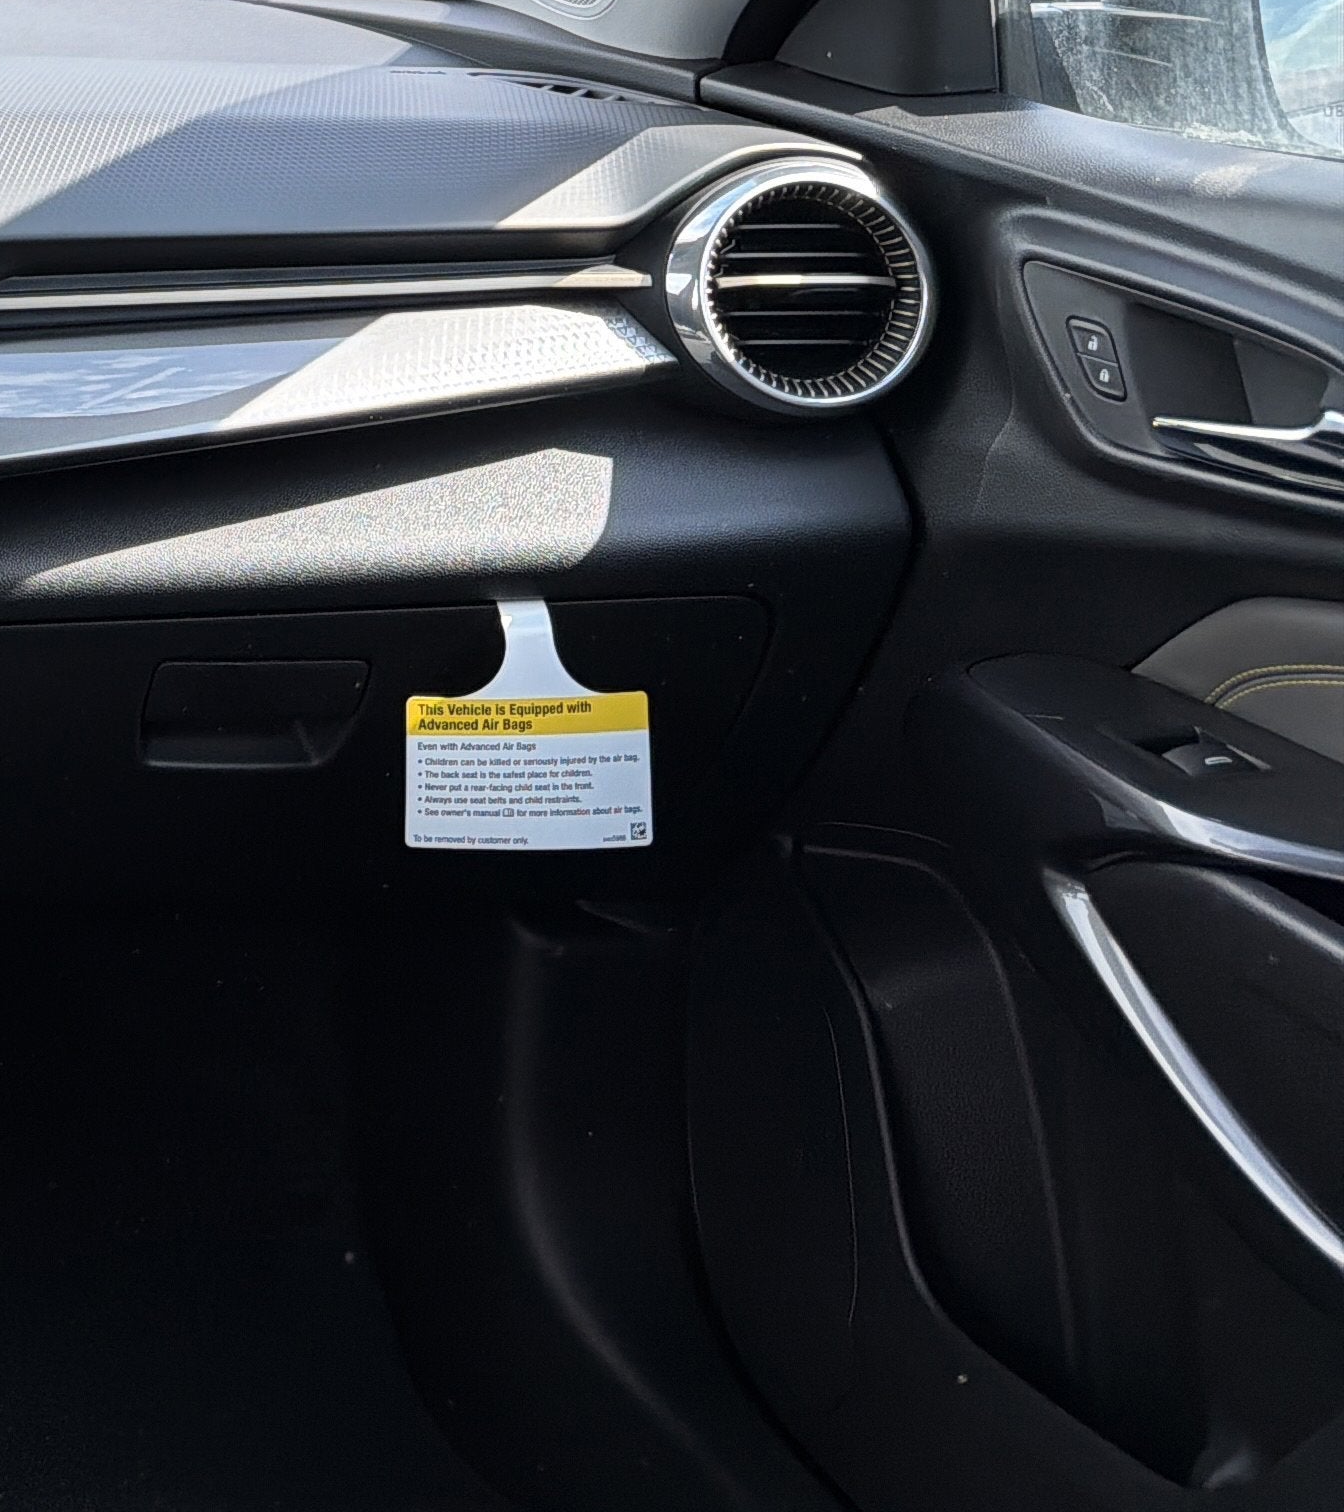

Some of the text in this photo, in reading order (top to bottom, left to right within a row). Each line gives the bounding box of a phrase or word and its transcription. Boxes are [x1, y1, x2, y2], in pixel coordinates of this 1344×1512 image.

[417, 700, 592, 718] This Vehicle is Equipped with
[417, 718, 533, 733] Advanced Air Bags
[417, 742, 537, 752] Even with Advanced Air Bags
[424, 757, 459, 766] Children
[477, 758, 488, 766] be
[489, 758, 511, 766] killed
[523, 757, 558, 766] seriously
[560, 756, 587, 766] injured
[588, 756, 597, 765] by
[599, 755, 611, 763] the
[613, 754, 622, 763] air
[624, 754, 640, 763] bag.
[424, 769, 593, 780] The back seat is the safest place for children.
[424, 808, 439, 816] See
[441, 808, 471, 817] owner's
[473, 809, 501, 817] manual
[516, 809, 527, 817] for
[549, 808, 591, 817] information
[592, 807, 612, 815] about
[613, 806, 623, 814] air
[624, 806, 643, 814] bags.
[413, 834, 529, 846] To be removed by customer only.
